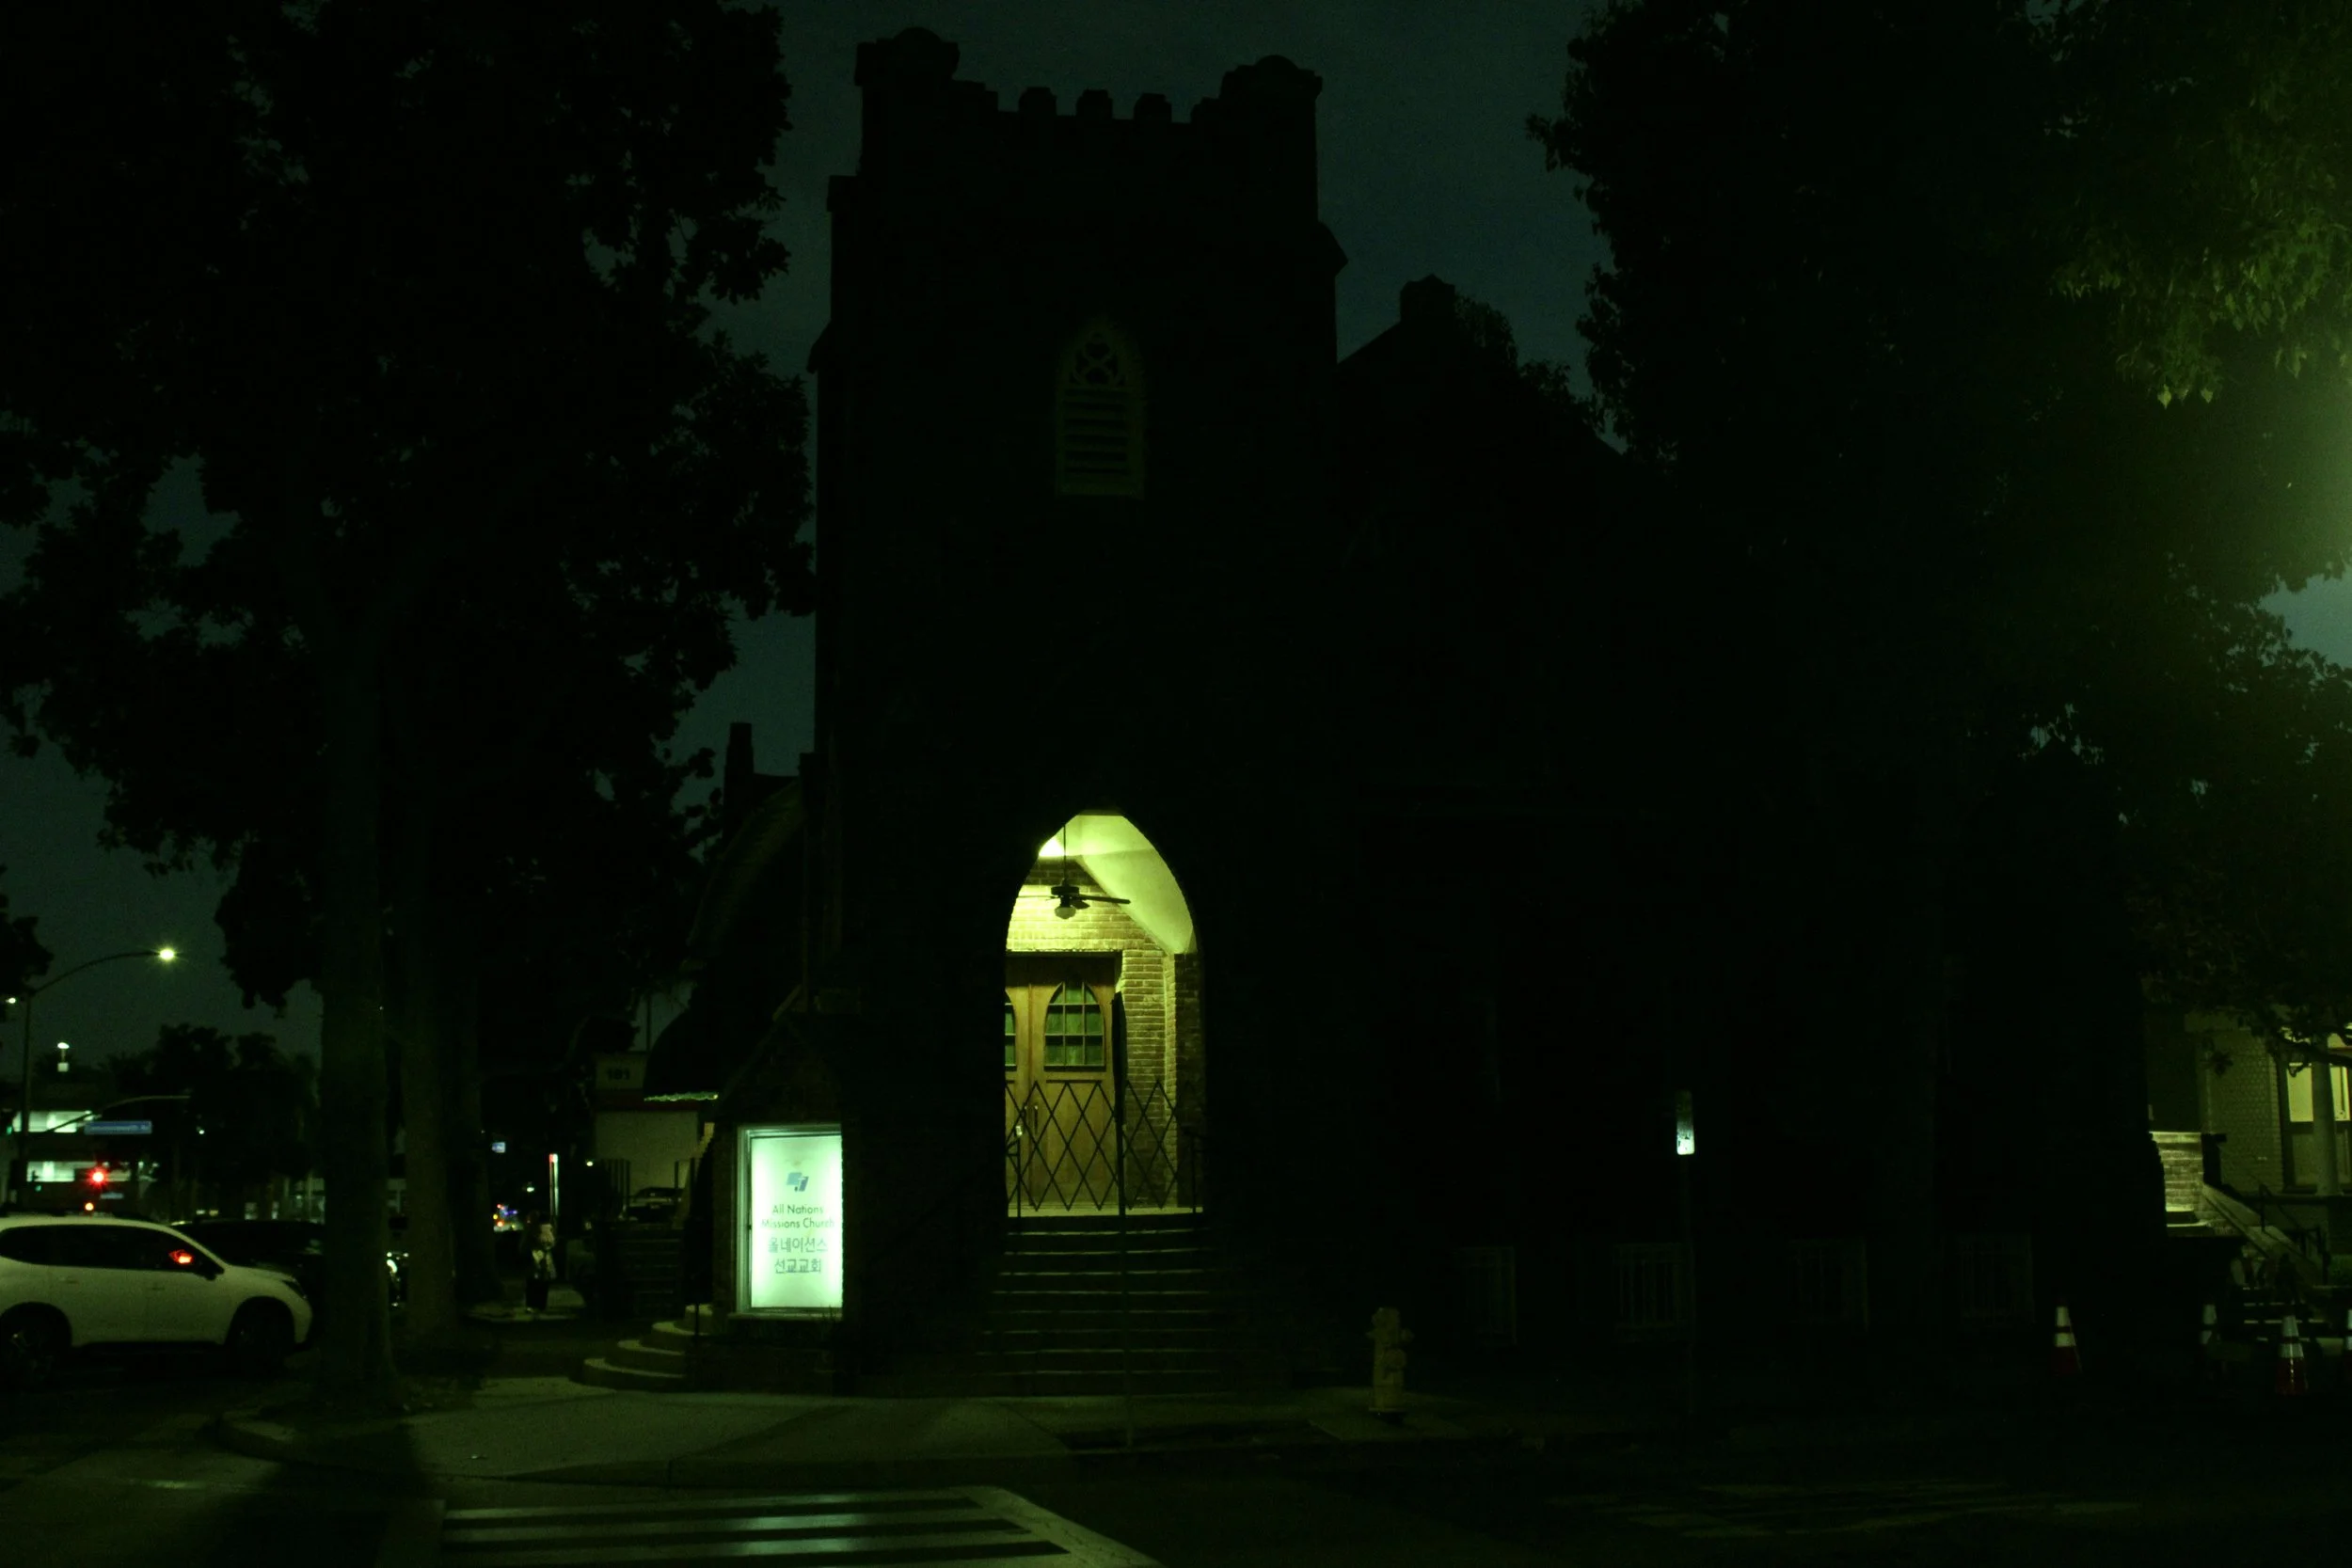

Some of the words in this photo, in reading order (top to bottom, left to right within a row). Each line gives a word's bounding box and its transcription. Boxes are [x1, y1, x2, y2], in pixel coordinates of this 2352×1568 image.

[772, 1204, 784, 1214] All
[787, 1204, 824, 1214] Nations
[761, 1219, 800, 1228] Missions
[803, 1217, 834, 1228] Church
[774, 1259, 820, 1274] 선교교회
